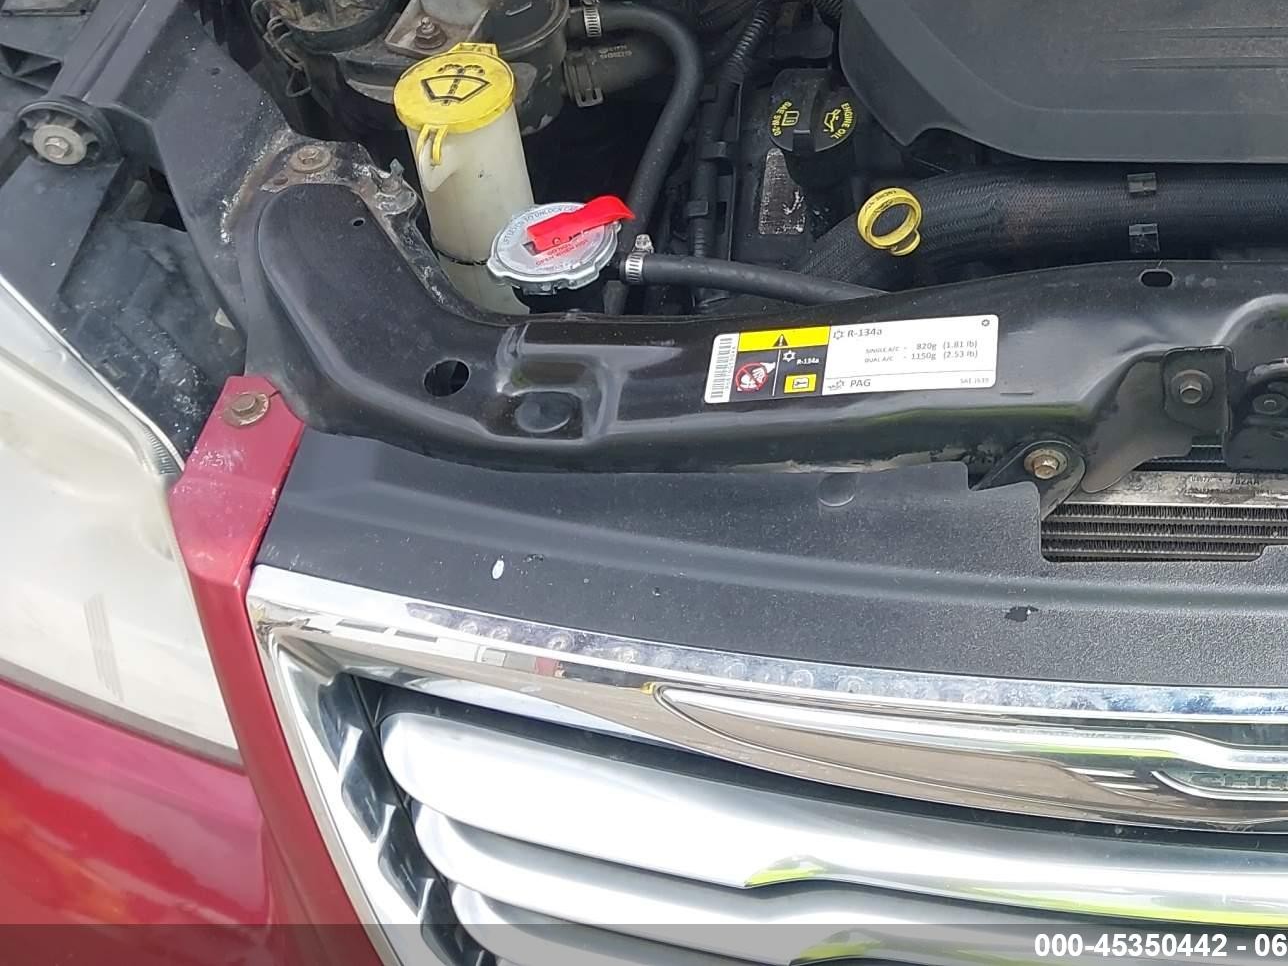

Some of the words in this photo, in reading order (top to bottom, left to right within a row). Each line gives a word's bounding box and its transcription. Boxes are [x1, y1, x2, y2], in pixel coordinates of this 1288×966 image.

[840, 102, 854, 129] ENGINE
[829, 128, 847, 140] OIL
[847, 328, 883, 338] R-134a
[916, 342, 937, 351] 820g
[942, 340, 964, 349] (1.81
[966, 339, 978, 349] lb)
[911, 352, 937, 361] 1150g
[943, 350, 964, 359] (2.53
[966, 349, 978, 359] lb)
[796, 357, 820, 366] R-134a
[849, 379, 872, 388] PAG
